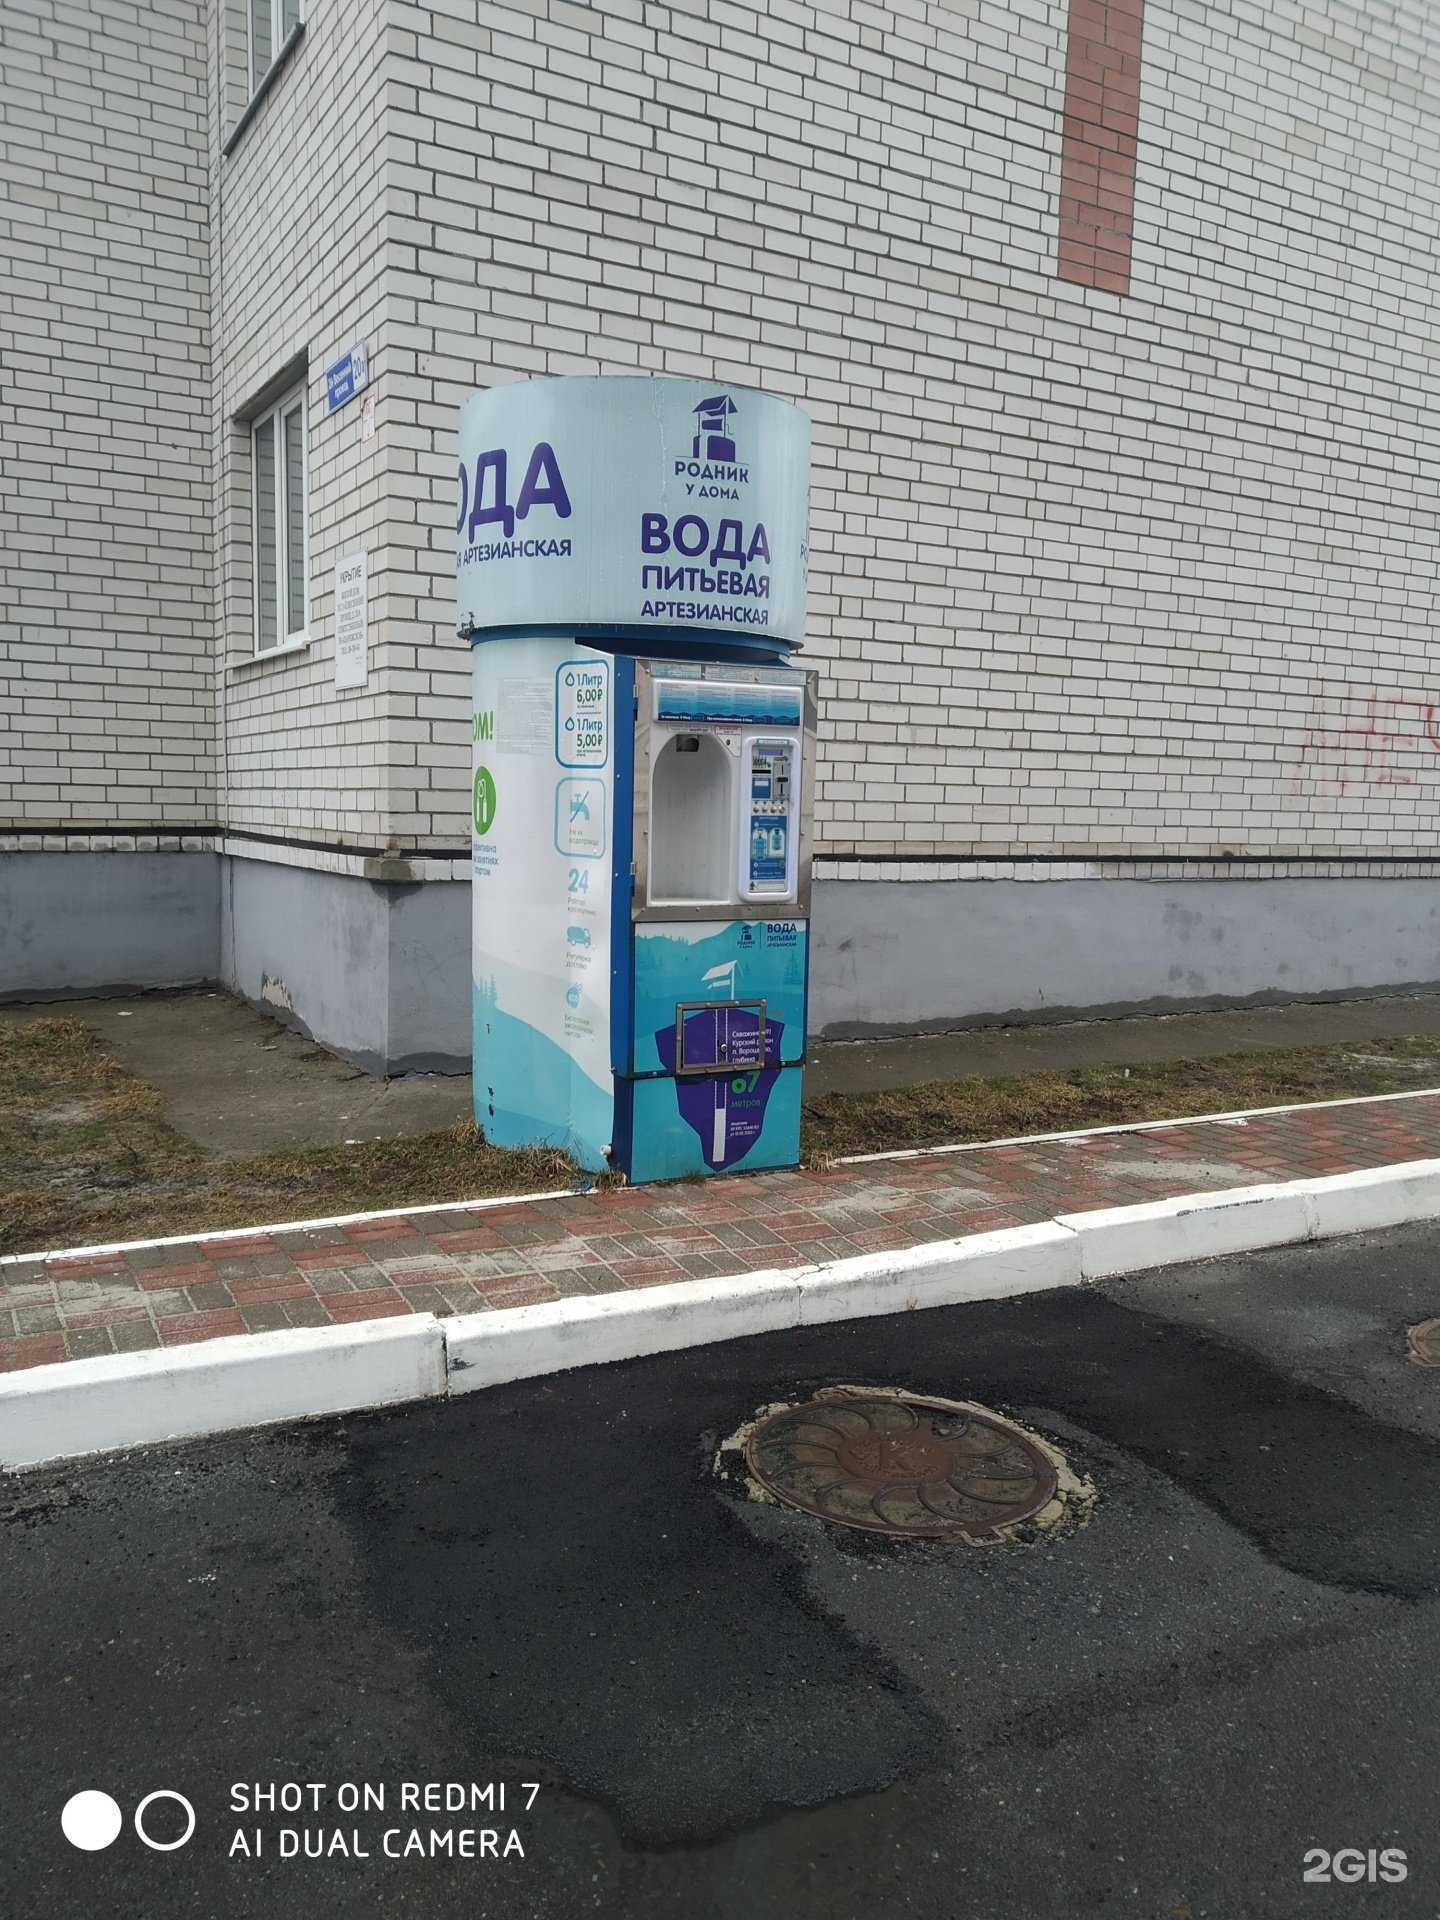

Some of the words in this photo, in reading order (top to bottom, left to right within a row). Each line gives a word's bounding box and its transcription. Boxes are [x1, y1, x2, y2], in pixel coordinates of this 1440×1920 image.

[674, 460, 749, 484] РОДНИК
[686, 483, 695, 496] У
[699, 485, 740, 501] ДОМА
[463, 539, 572, 567] АРТЕЗИАНСКАЯ
[640, 512, 771, 570] ВОДА
[641, 564, 770, 599] ПИТЬЕВАЯ
[640, 600, 769, 625] АРТЕЗИАНСКАЯ
[567, 867, 589, 894] 24
[767, 923, 798, 934] ВОДА
